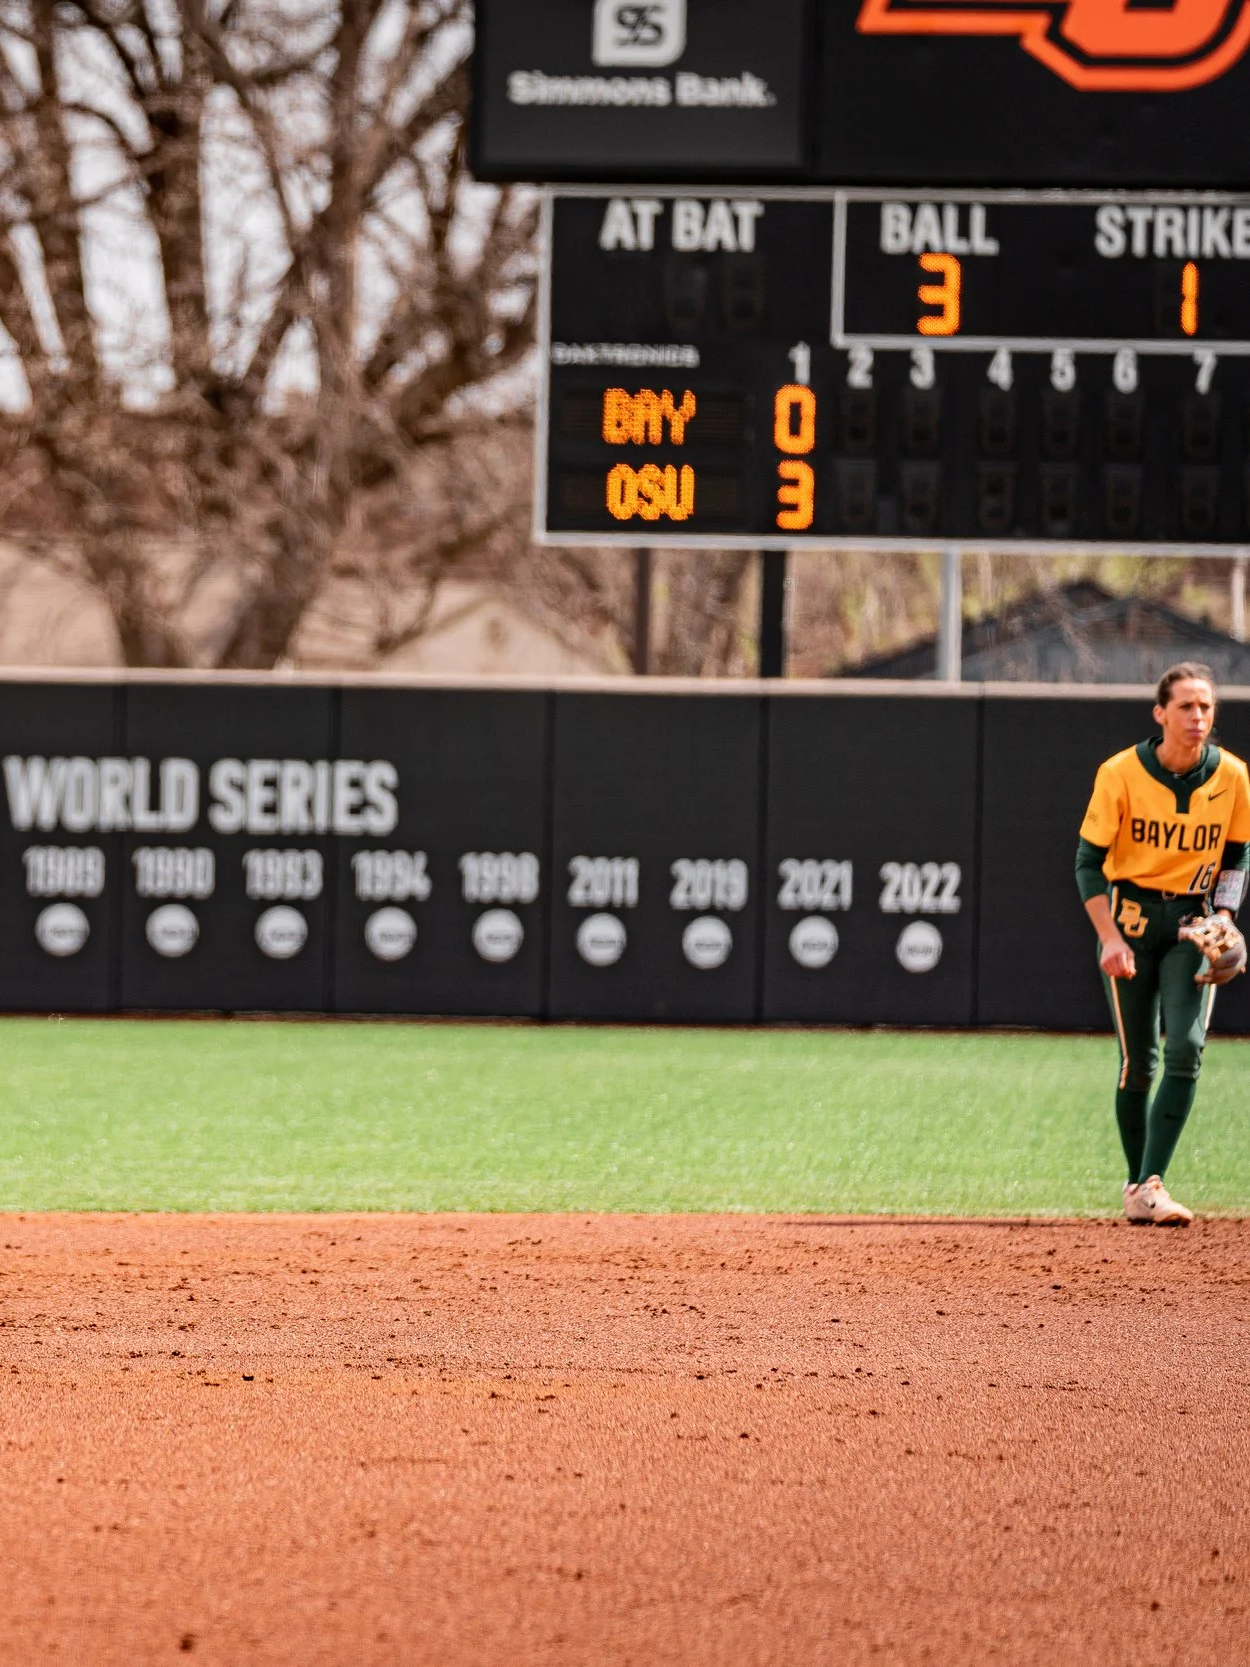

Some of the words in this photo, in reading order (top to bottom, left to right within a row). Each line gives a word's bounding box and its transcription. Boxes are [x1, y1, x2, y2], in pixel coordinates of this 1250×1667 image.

[508, 70, 672, 106] Simmons
[600, 201, 661, 251] AT
[671, 201, 762, 252] BAT
[881, 205, 999, 254] BALL
[917, 252, 961, 336] 3
[1180, 261, 1198, 336] 1
[788, 343, 811, 385] 1
[847, 352, 873, 389] 2
[909, 353, 935, 390] 3
[987, 354, 1013, 390] 4
[1049, 354, 1075, 391] 5
[1111, 355, 1138, 392] 6
[1193, 355, 1217, 393] 7
[603, 388, 696, 445] BAY
[774, 384, 816, 454] 0
[606, 463, 694, 520] OSU
[776, 460, 814, 530] 3
[3, 755, 200, 832] WORLD
[209, 758, 398, 836] SERIES
[1132, 818, 1222, 852] BAYLOR
[132, 847, 215, 899] 1990
[243, 849, 323, 900] 1993
[352, 850, 432, 901] 1994
[568, 856, 639, 907] 2011
[670, 859, 748, 910] 2019
[778, 859, 852, 910] 2021
[880, 862, 961, 913] 2022
